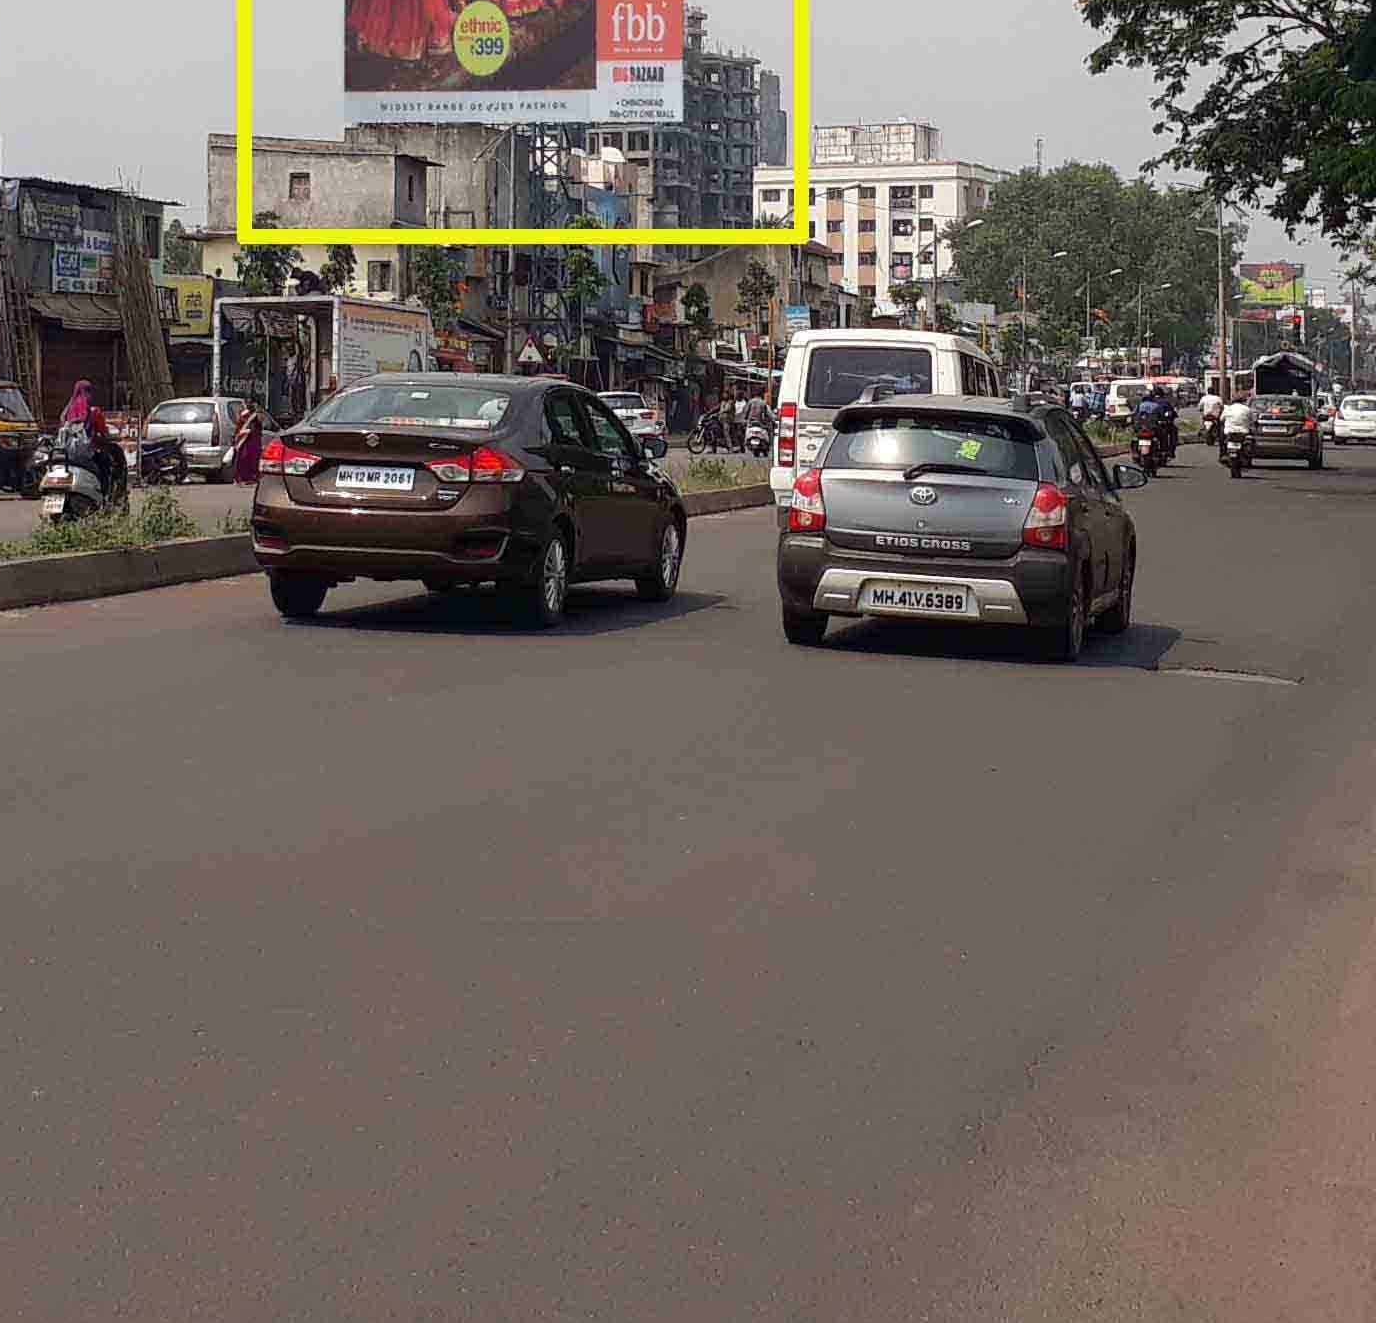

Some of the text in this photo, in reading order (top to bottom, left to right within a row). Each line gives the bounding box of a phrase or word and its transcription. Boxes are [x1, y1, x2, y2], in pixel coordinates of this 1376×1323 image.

[460, 17, 502, 34] ethnic
[612, 2, 666, 42] fbb
[379, 101, 422, 112] WIDEST
[428, 101, 464, 112] RANGE
[519, 100, 568, 110] FASHION
[876, 535, 971, 551] ETIOS CROSS
